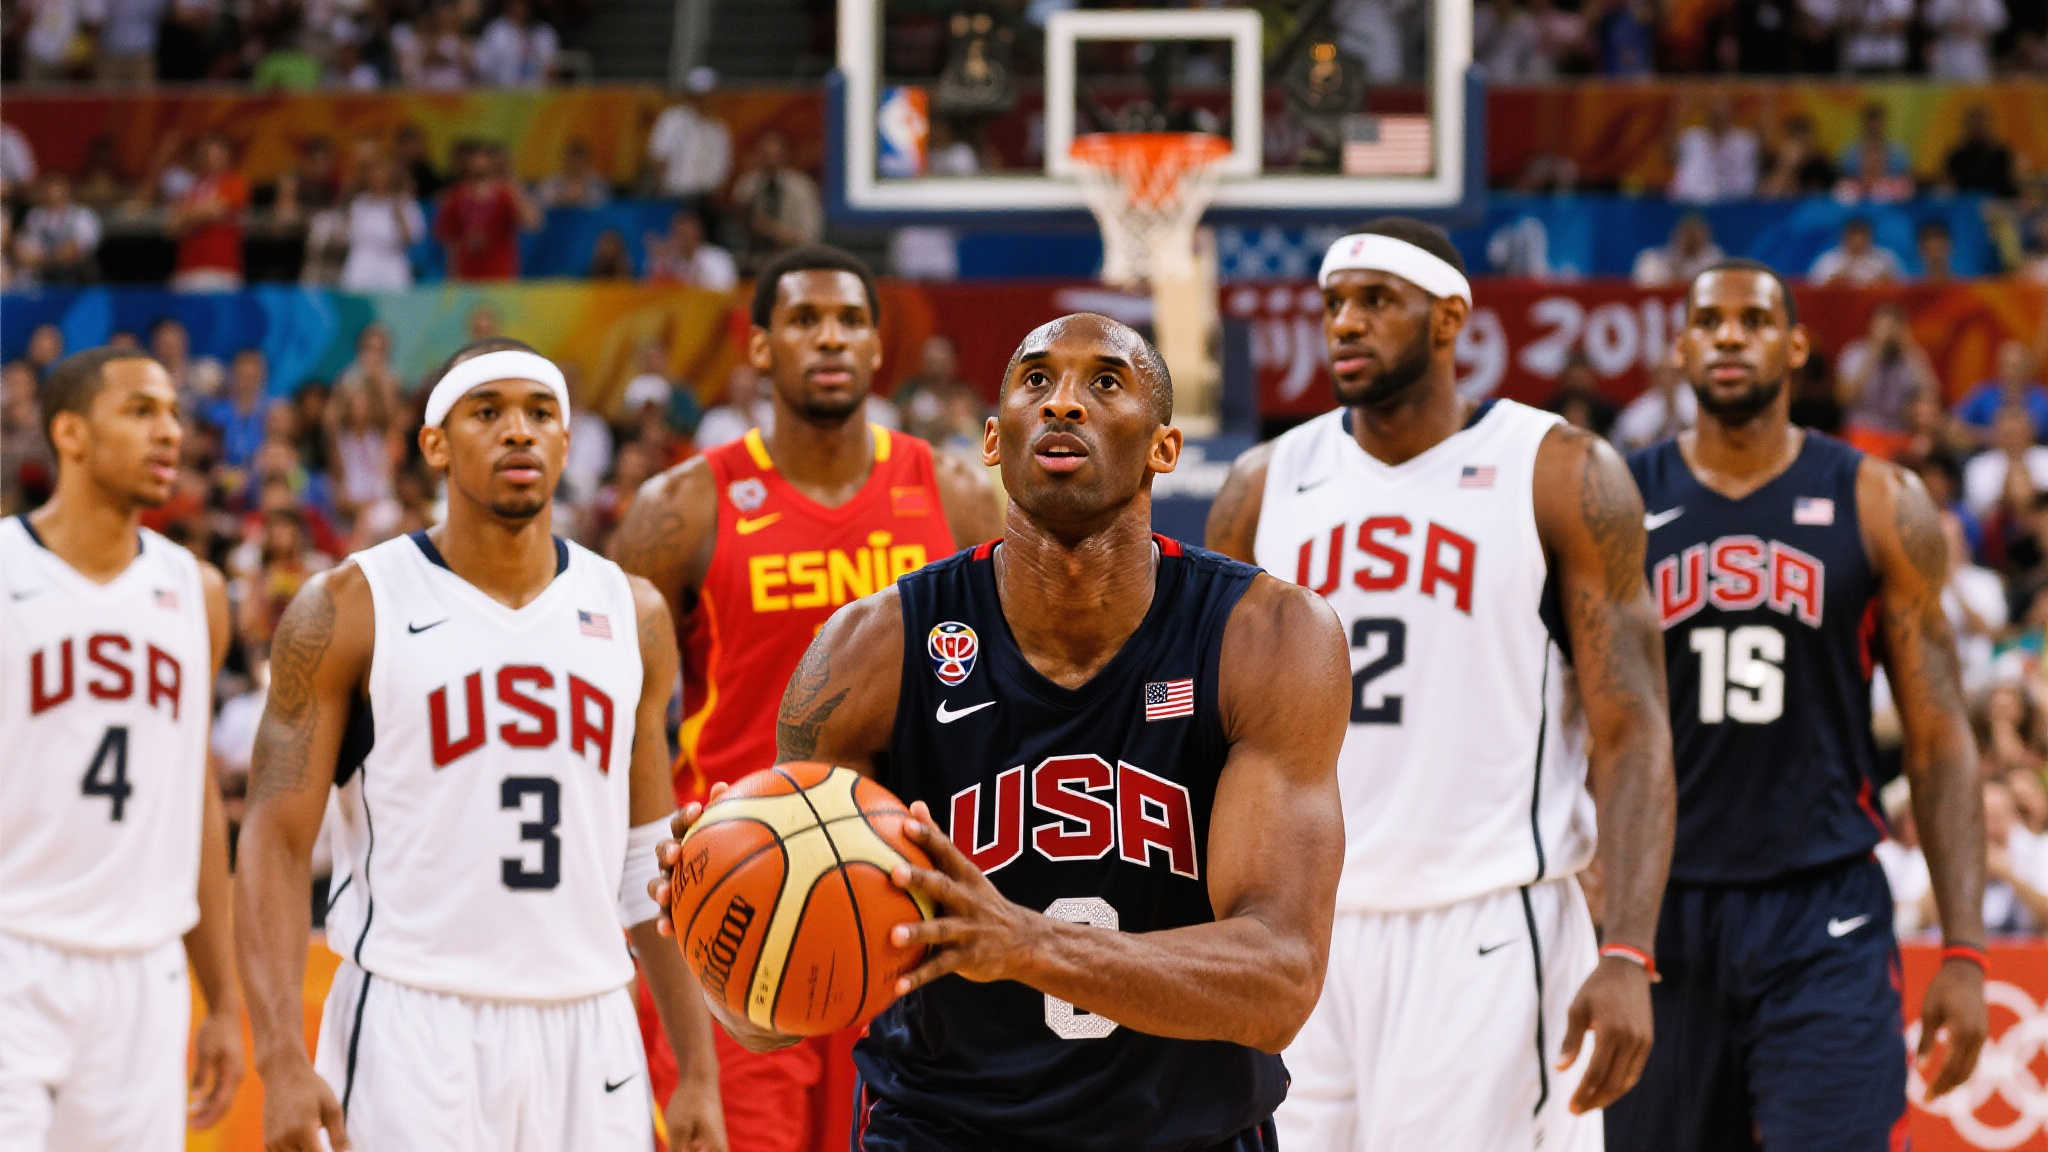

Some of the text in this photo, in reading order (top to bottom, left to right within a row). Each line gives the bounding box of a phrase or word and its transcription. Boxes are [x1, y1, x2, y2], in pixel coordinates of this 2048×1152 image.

[1297, 514, 1477, 616] USA
[1653, 535, 1825, 630] USA
[29, 632, 182, 721] USA
[427, 664, 614, 778] USA
[1350, 616, 1406, 726] 2
[81, 726, 134, 822] 4
[950, 753, 1199, 881] USA
[501, 776, 561, 891] 3
